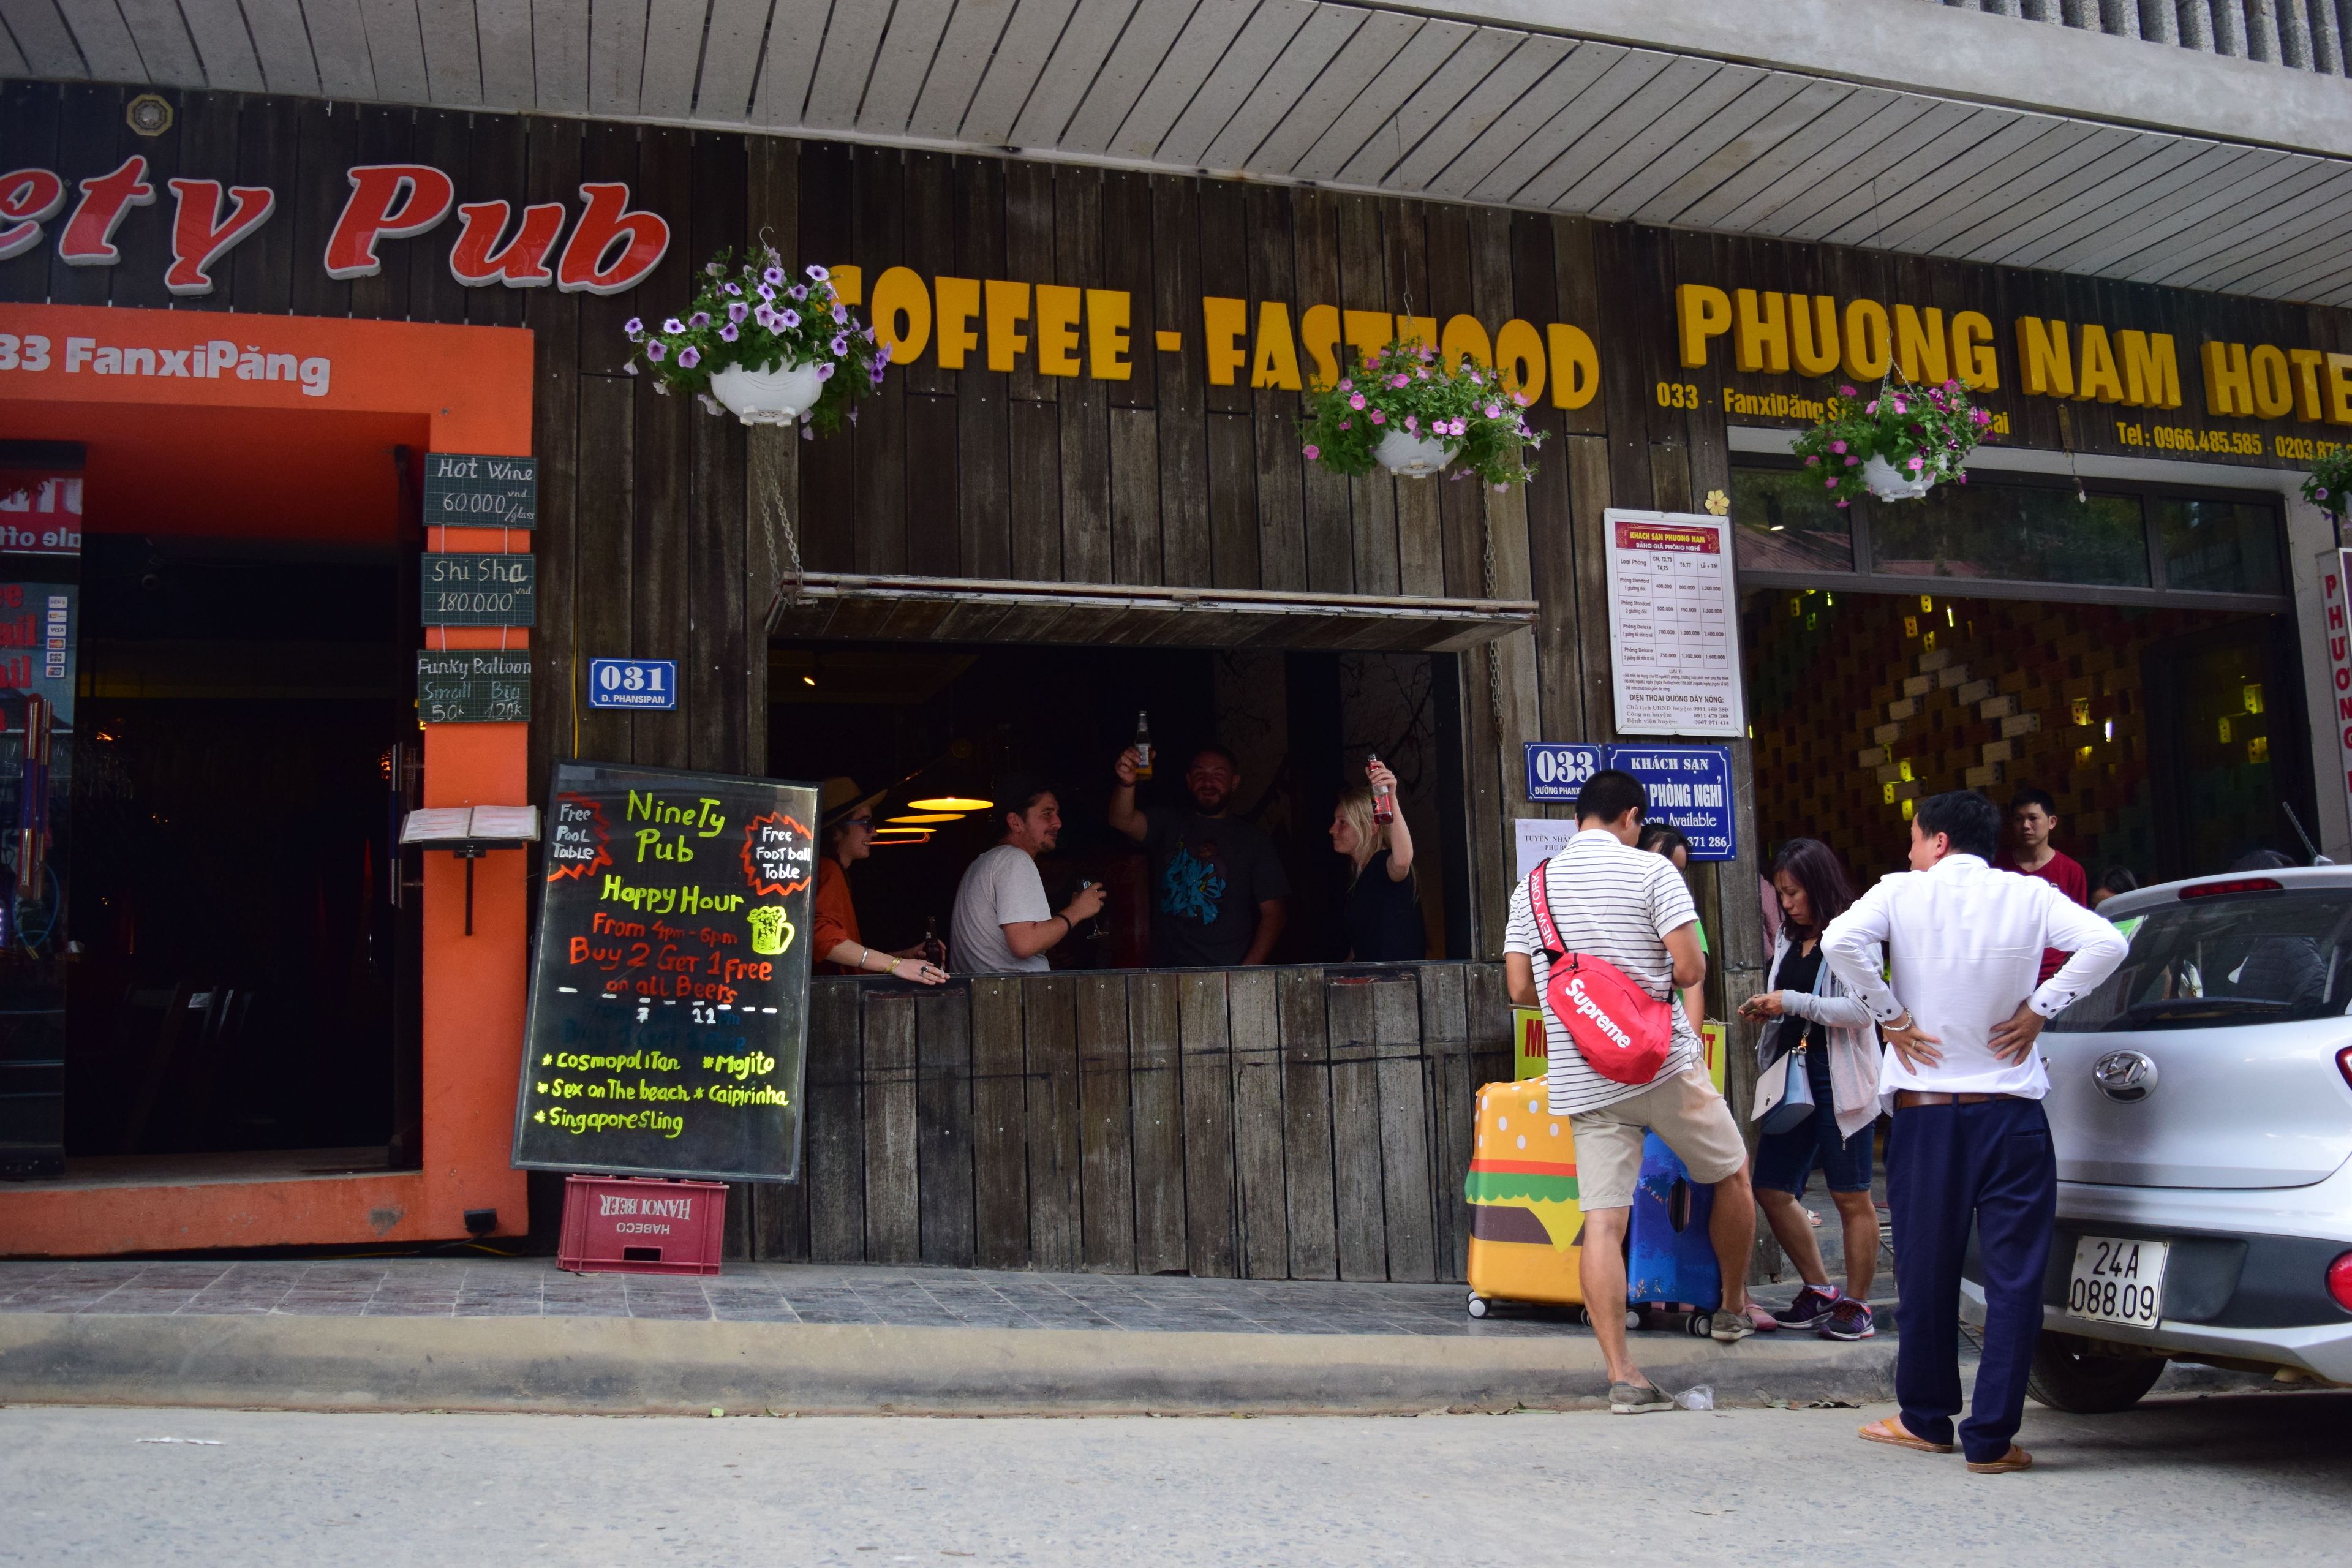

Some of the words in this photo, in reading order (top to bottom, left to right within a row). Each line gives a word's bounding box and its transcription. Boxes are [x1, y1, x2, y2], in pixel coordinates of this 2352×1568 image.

[325, 164, 671, 295] Pub
[1676, 284, 1997, 393] PHUONG
[2016, 316, 2182, 410] NAM
[1656, 382, 1698, 409] 033
[1722, 388, 1825, 425] Fanxipăng
[2154, 426, 2262, 454] 0966.485.585
[437, 458, 478, 478] Hot
[488, 461, 533, 481] Wine
[508, 489, 527, 497] vnd
[432, 560, 469, 581] Shi
[479, 559, 528, 582] Sha
[437, 593, 513, 612] 180.000
[514, 586, 532, 594] vnd
[418, 659, 468, 679] Funky
[473, 656, 532, 674] Balloon
[600, 666, 666, 691] 031
[424, 682, 471, 701] Small
[491, 681, 520, 704] Big
[613, 695, 665, 704] PHANSIPAN
[1645, 695, 1664, 704] THOẠI
[1690, 694, 1703, 703] DÂY
[1536, 751, 1595, 783] 033
[1630, 756, 1678, 771] KHÁCH
[1683, 758, 1709, 774] SẠN
[1534, 785, 1558, 795] ĐƯỜNG
[1649, 778, 1691, 808] PHÒNG
[1694, 775, 1723, 808] NGHỈ
[560, 804, 592, 822] Free
[1642, 816, 1664, 826] oom
[1668, 812, 1717, 827] Available
[635, 829, 695, 862] Pub
[763, 826, 793, 843] Free
[1687, 837, 1705, 847] 871
[1708, 837, 1727, 847] 286
[680, 886, 744, 915] Hour
[1531, 871, 1542, 911] YORK
[592, 913, 644, 938] From
[652, 920, 685, 943] 4pm
[699, 927, 738, 949] 6pm
[1537, 913, 1555, 946] NEW
[570, 936, 623, 971] Buy
[627, 943, 651, 968] 2
[707, 951, 721, 973] 1
[725, 958, 773, 983] Free
[636, 978, 669, 997] all
[676, 978, 738, 1005] Beers
[692, 1008, 716, 1024] 11
[1565, 979, 1631, 1049] Supreme
[715, 1051, 775, 1080] Mojito
[552, 1079, 584, 1098] Sex
[588, 1087, 605, 1098] on
[639, 1079, 691, 1101] beach
[600, 1194, 639, 1216] BEER
[641, 1199, 692, 1220] HANOI
[616, 1222, 670, 1235] HABECO
[2092, 1242, 2139, 1280] 24A
[2071, 1278, 2154, 1321] 088.09
